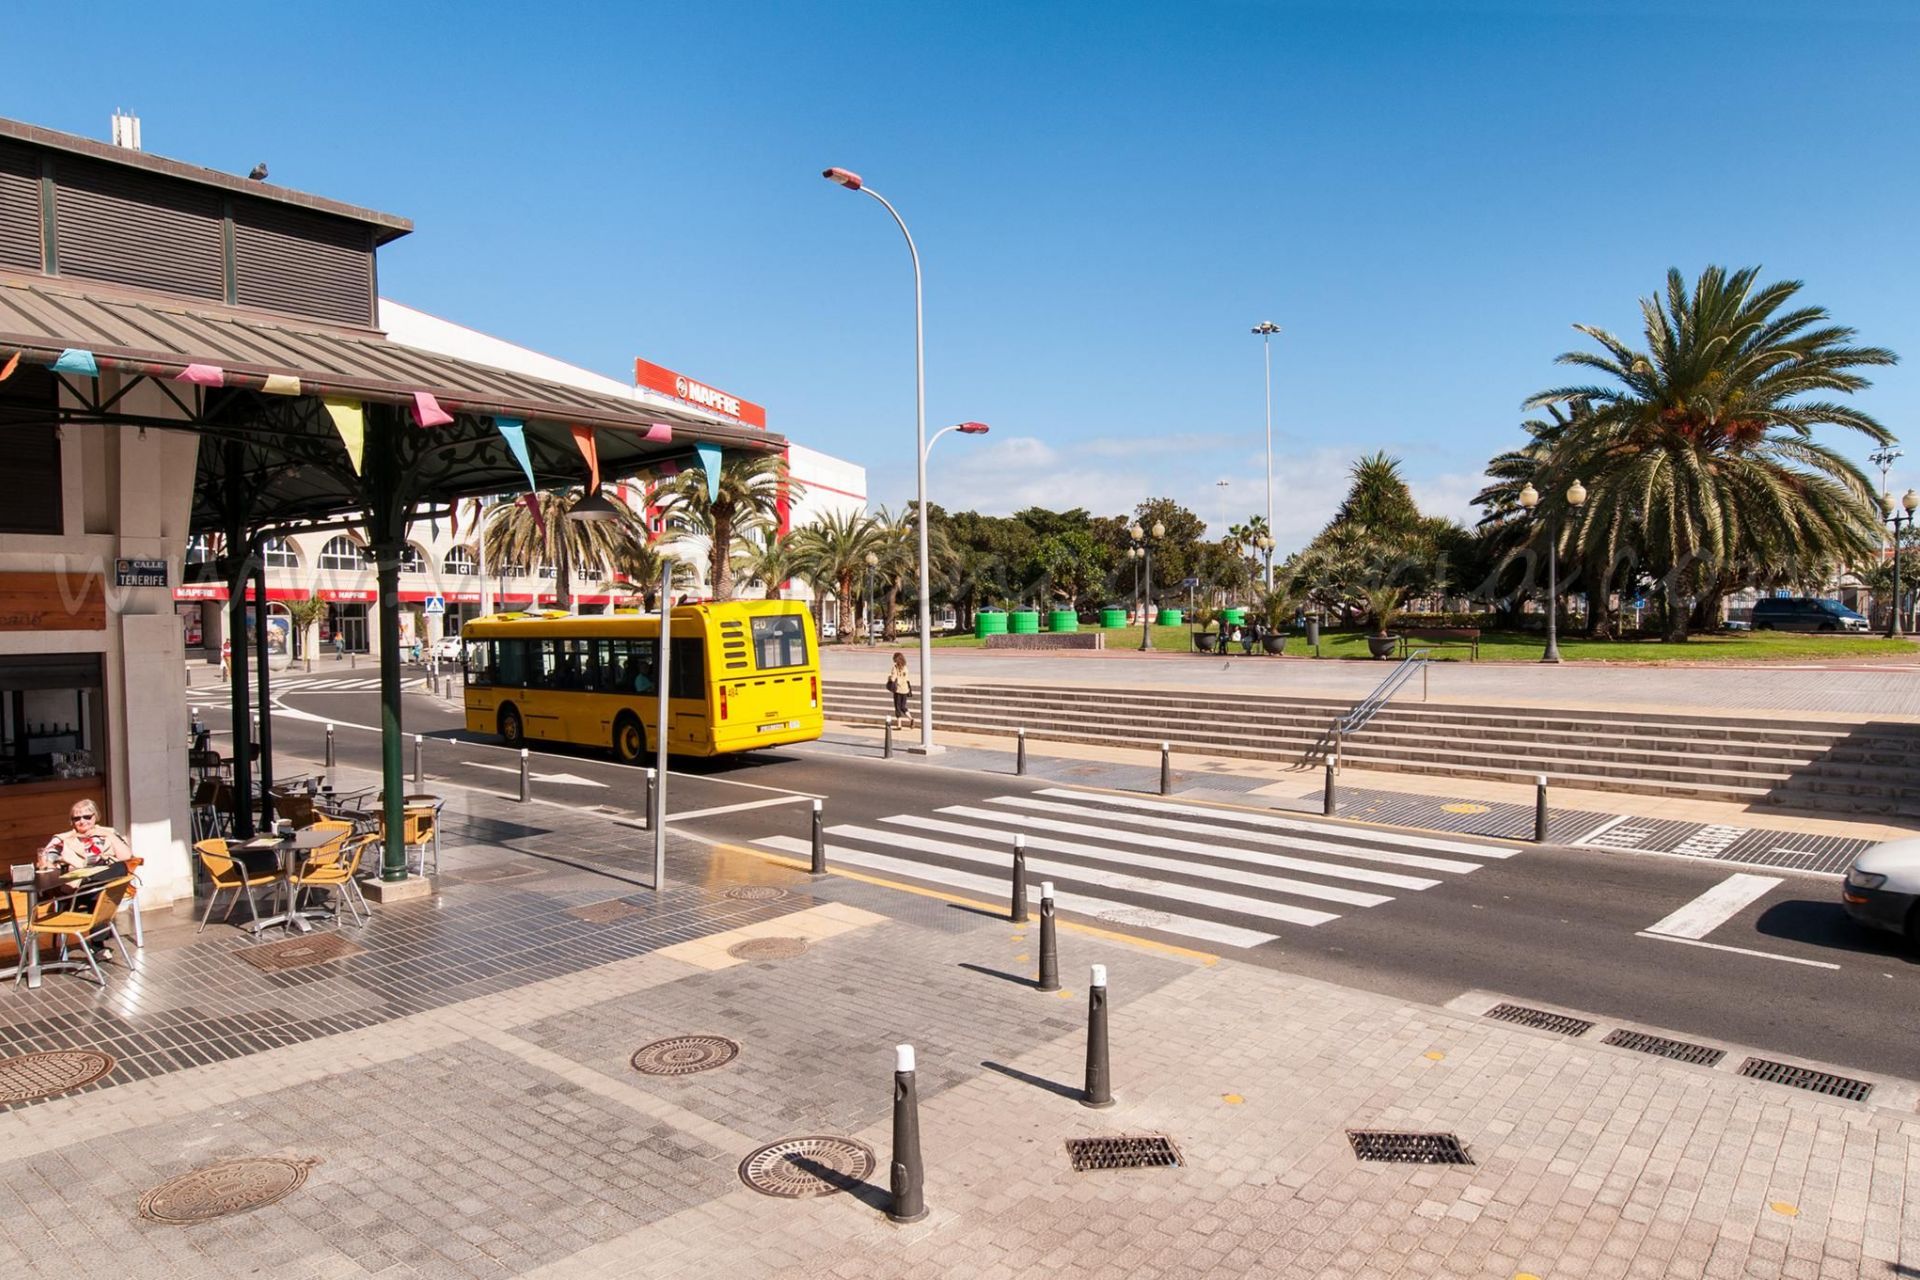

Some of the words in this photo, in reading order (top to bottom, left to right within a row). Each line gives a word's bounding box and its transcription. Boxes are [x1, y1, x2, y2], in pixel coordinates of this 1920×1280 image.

[689, 381, 740, 416] MAPFRE
[133, 561, 164, 569] CALLE
[120, 574, 164, 586] TENERIFE
[176, 588, 216, 598] MAPFRE
[338, 591, 368, 599] MAPFRE
